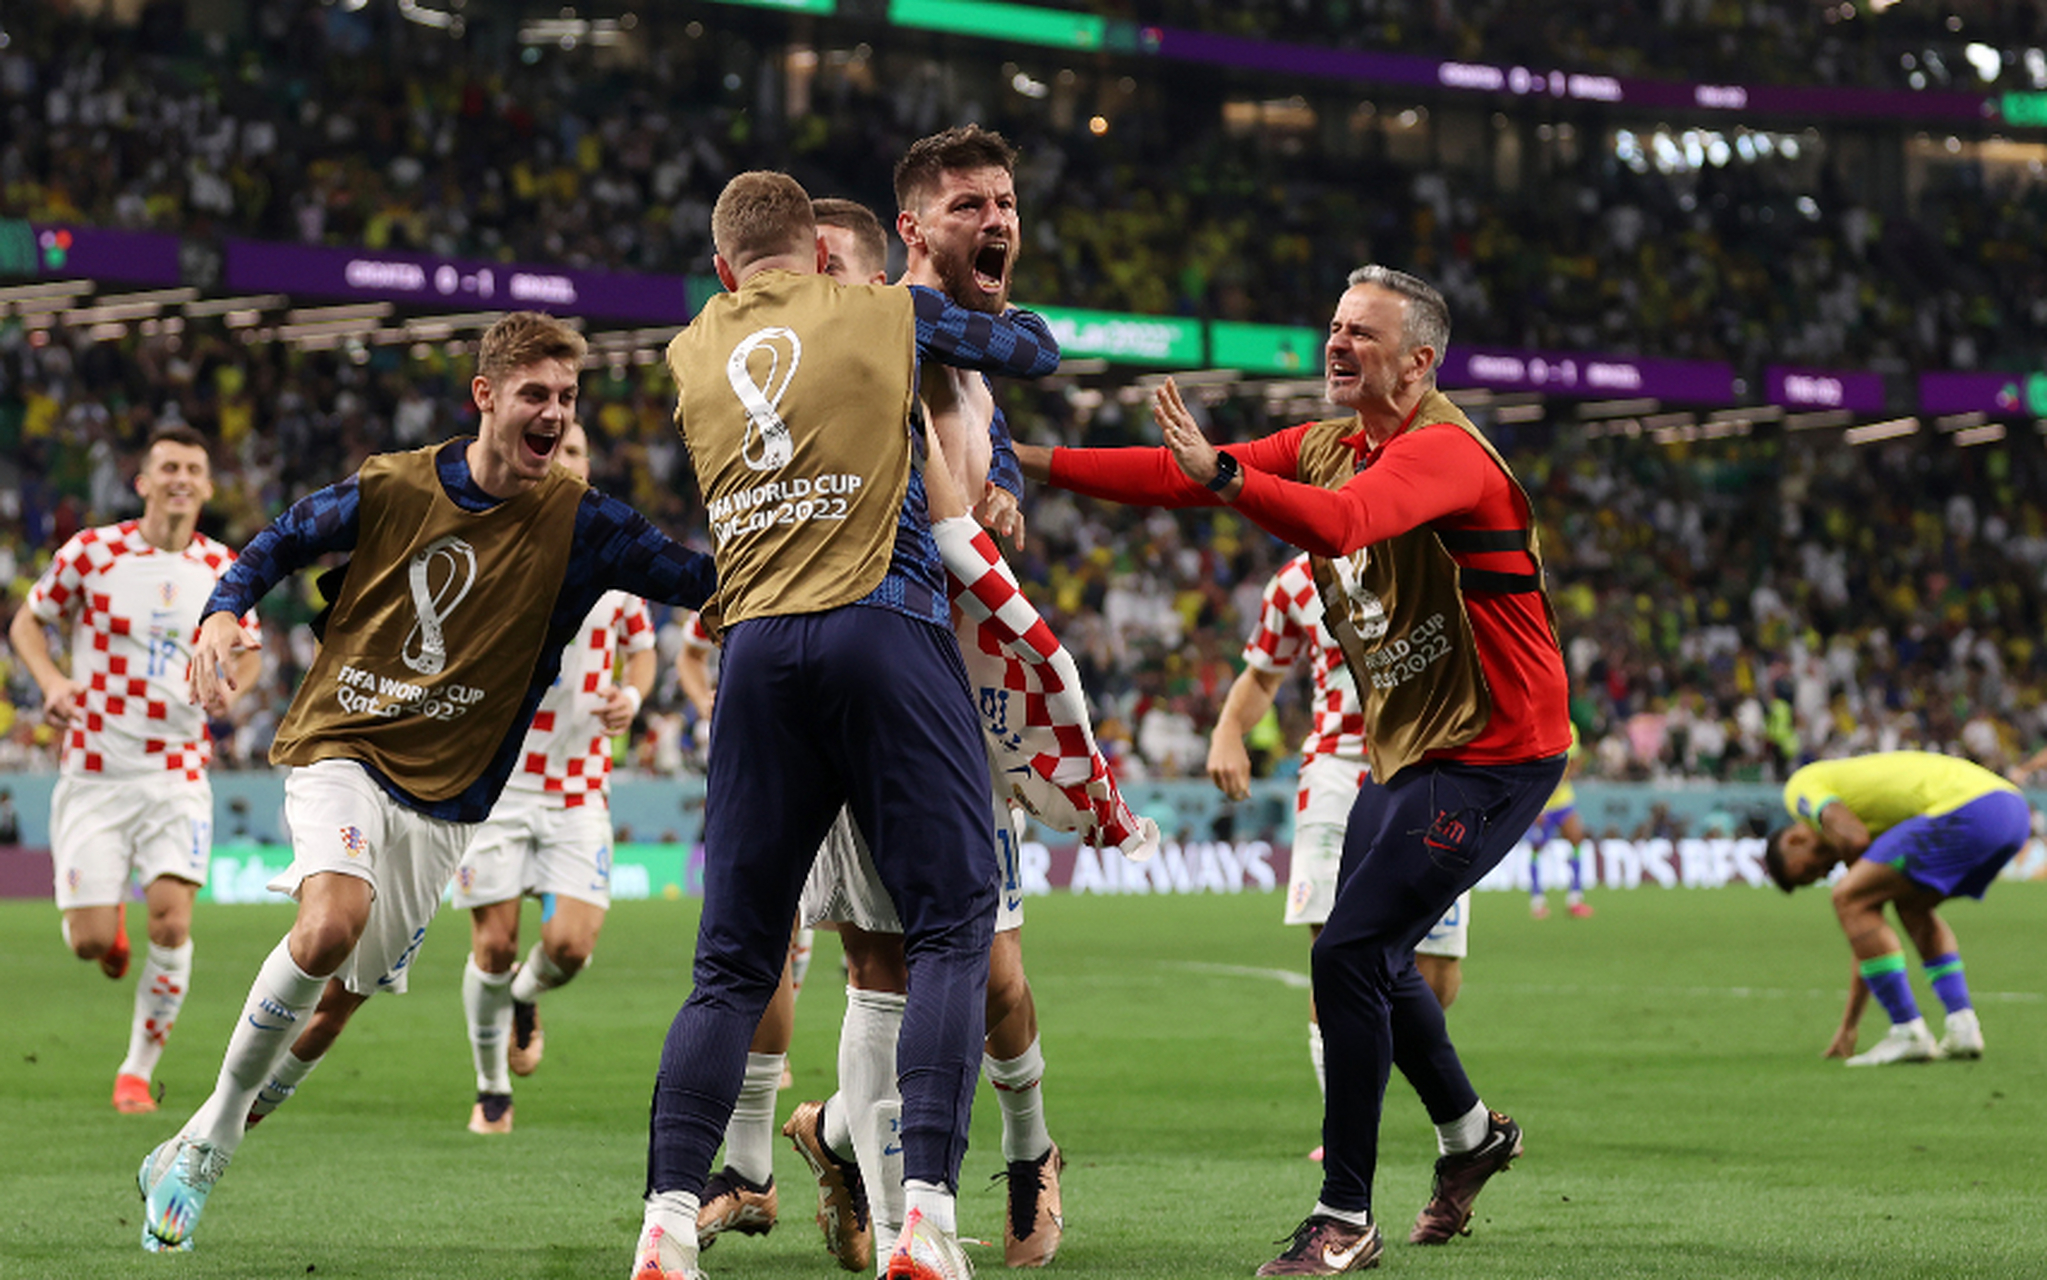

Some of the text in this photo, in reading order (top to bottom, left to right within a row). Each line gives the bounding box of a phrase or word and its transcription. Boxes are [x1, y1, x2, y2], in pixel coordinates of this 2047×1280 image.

[732, 478, 811, 512] WORLD
[814, 474, 862, 495] CUP
[1409, 613, 1445, 645] CUP
[337, 665, 376, 692] FIFA
[447, 684, 485, 704] CUP
